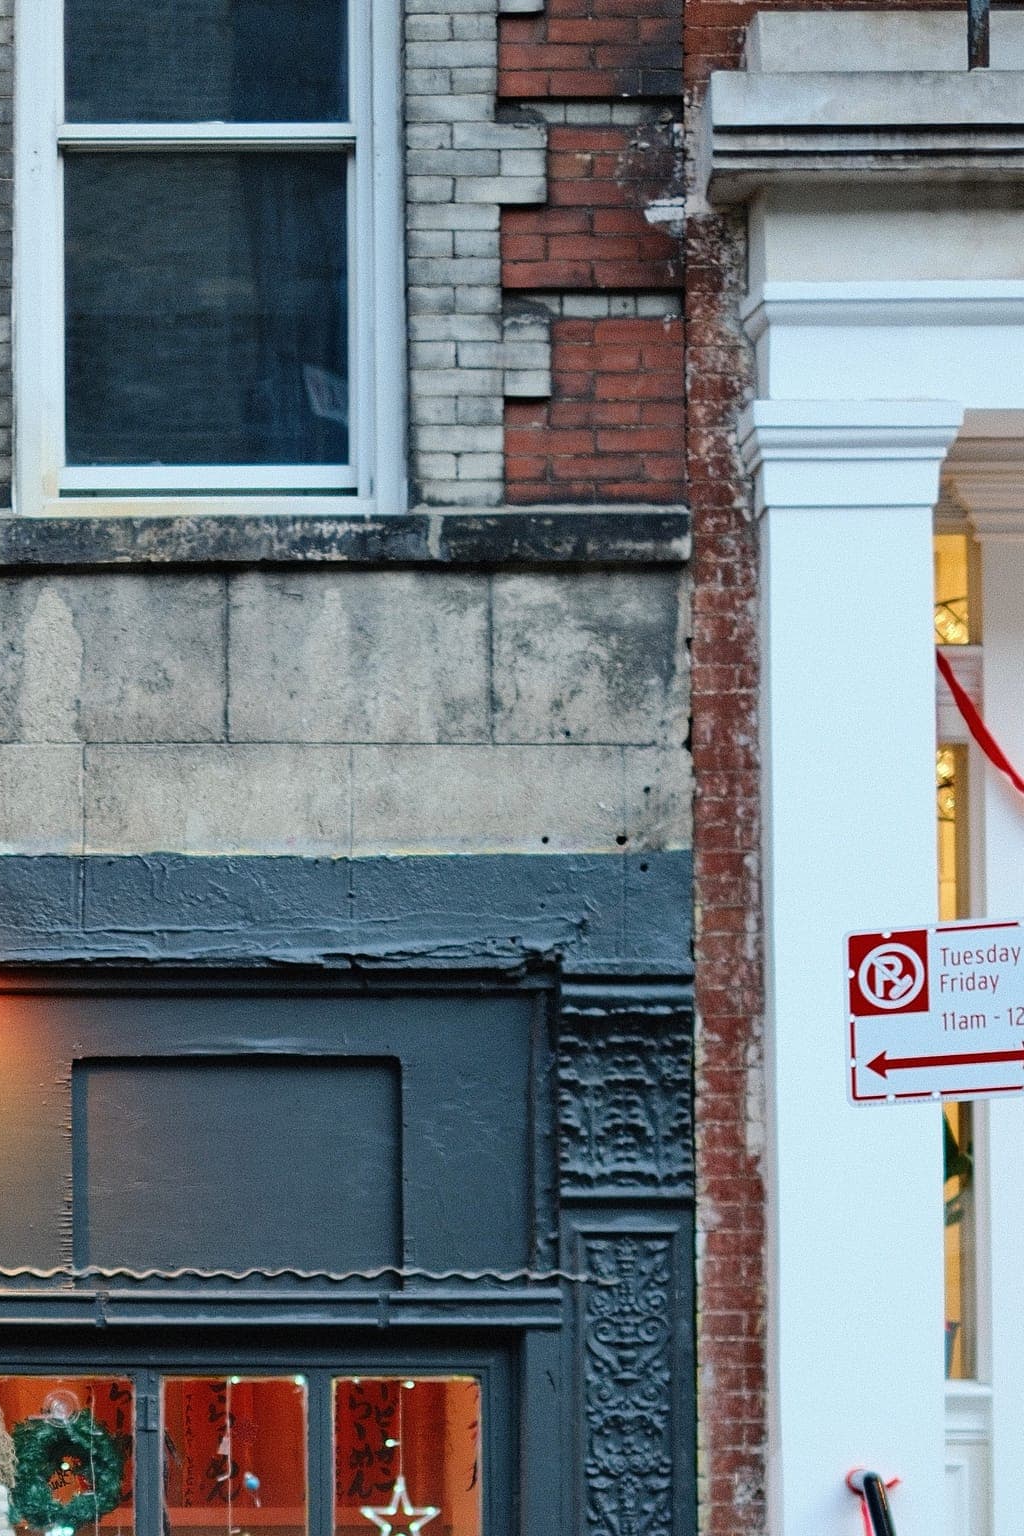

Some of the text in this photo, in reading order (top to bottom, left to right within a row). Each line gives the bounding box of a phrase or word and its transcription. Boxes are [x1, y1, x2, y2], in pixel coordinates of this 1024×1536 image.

[940, 944, 1021, 967] Tuesday
[940, 972, 1000, 994] Friday
[942, 1011, 987, 1031] 11am
